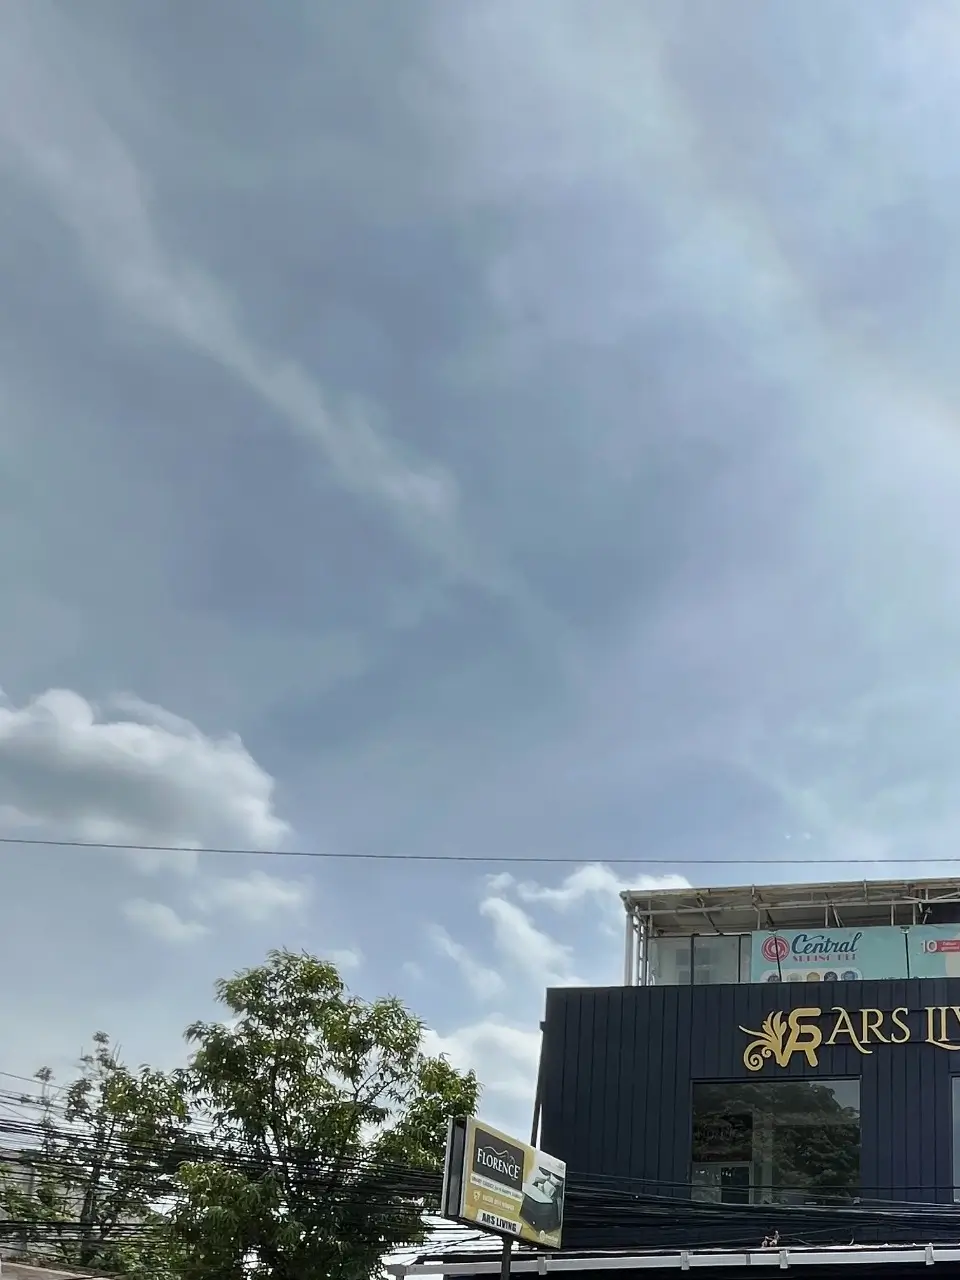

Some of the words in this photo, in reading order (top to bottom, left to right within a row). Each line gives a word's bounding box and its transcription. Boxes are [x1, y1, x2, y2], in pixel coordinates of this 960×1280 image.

[791, 931, 864, 956] Central
[920, 939, 938, 953] 10
[825, 1006, 911, 1054] ARS
[477, 1147, 521, 1179] FLORENCE
[481, 1212, 495, 1225] ARS
[496, 1217, 517, 1233] LIVING
